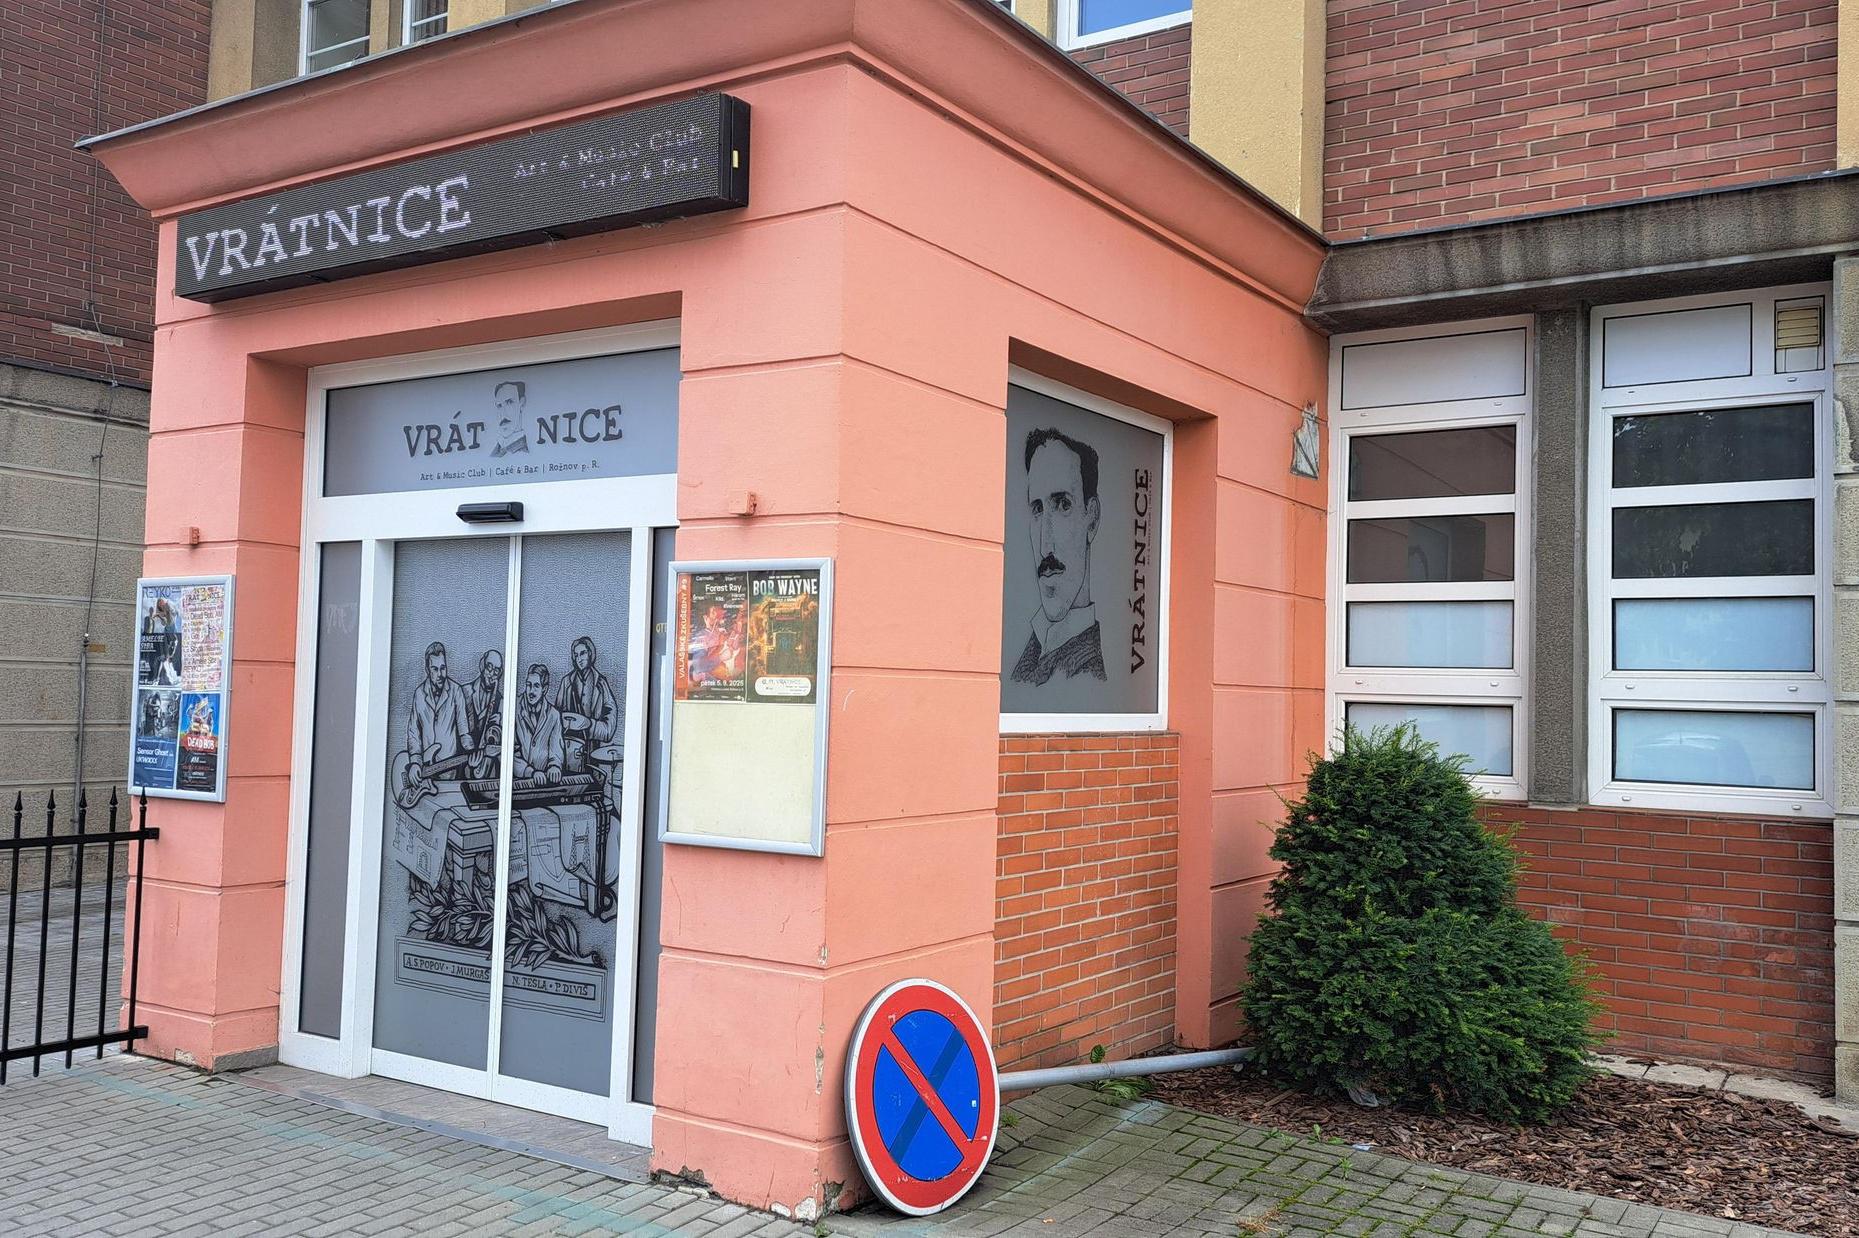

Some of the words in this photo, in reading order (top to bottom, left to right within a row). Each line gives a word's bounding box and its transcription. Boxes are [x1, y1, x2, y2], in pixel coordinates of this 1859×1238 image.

[185, 174, 471, 281] VRÁTNICE
[403, 411, 485, 457] VRÁT
[536, 405, 623, 444] NICE
[420, 473, 433, 481] Art
[443, 471, 465, 480] Music
[467, 468, 486, 478] Club
[495, 466, 514, 476] Café
[524, 464, 539, 474] Bar
[705, 584, 728, 592] Forest
[729, 583, 742, 592] Ray
[752, 580, 775, 596] BOB
[777, 578, 818, 596] WAYNE
[1128, 468, 1149, 674] VRÁTNICE
